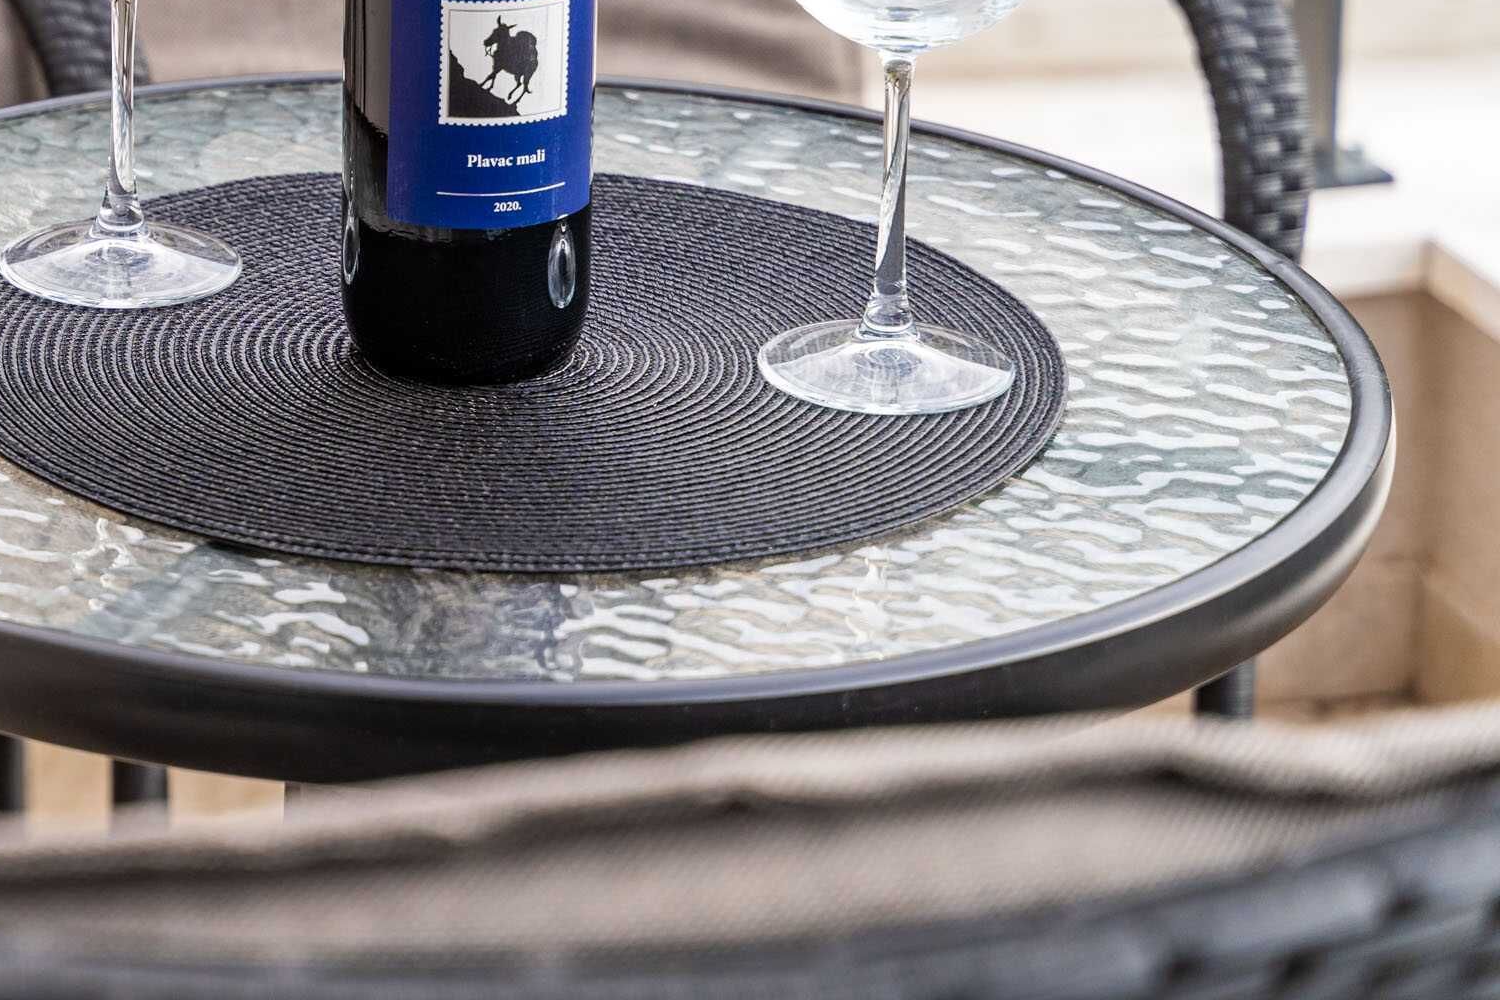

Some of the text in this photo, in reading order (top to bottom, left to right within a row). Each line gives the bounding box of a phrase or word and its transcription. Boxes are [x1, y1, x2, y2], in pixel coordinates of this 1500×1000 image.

[467, 149, 546, 168] Plavac mali
[493, 202, 522, 213] 2020.
